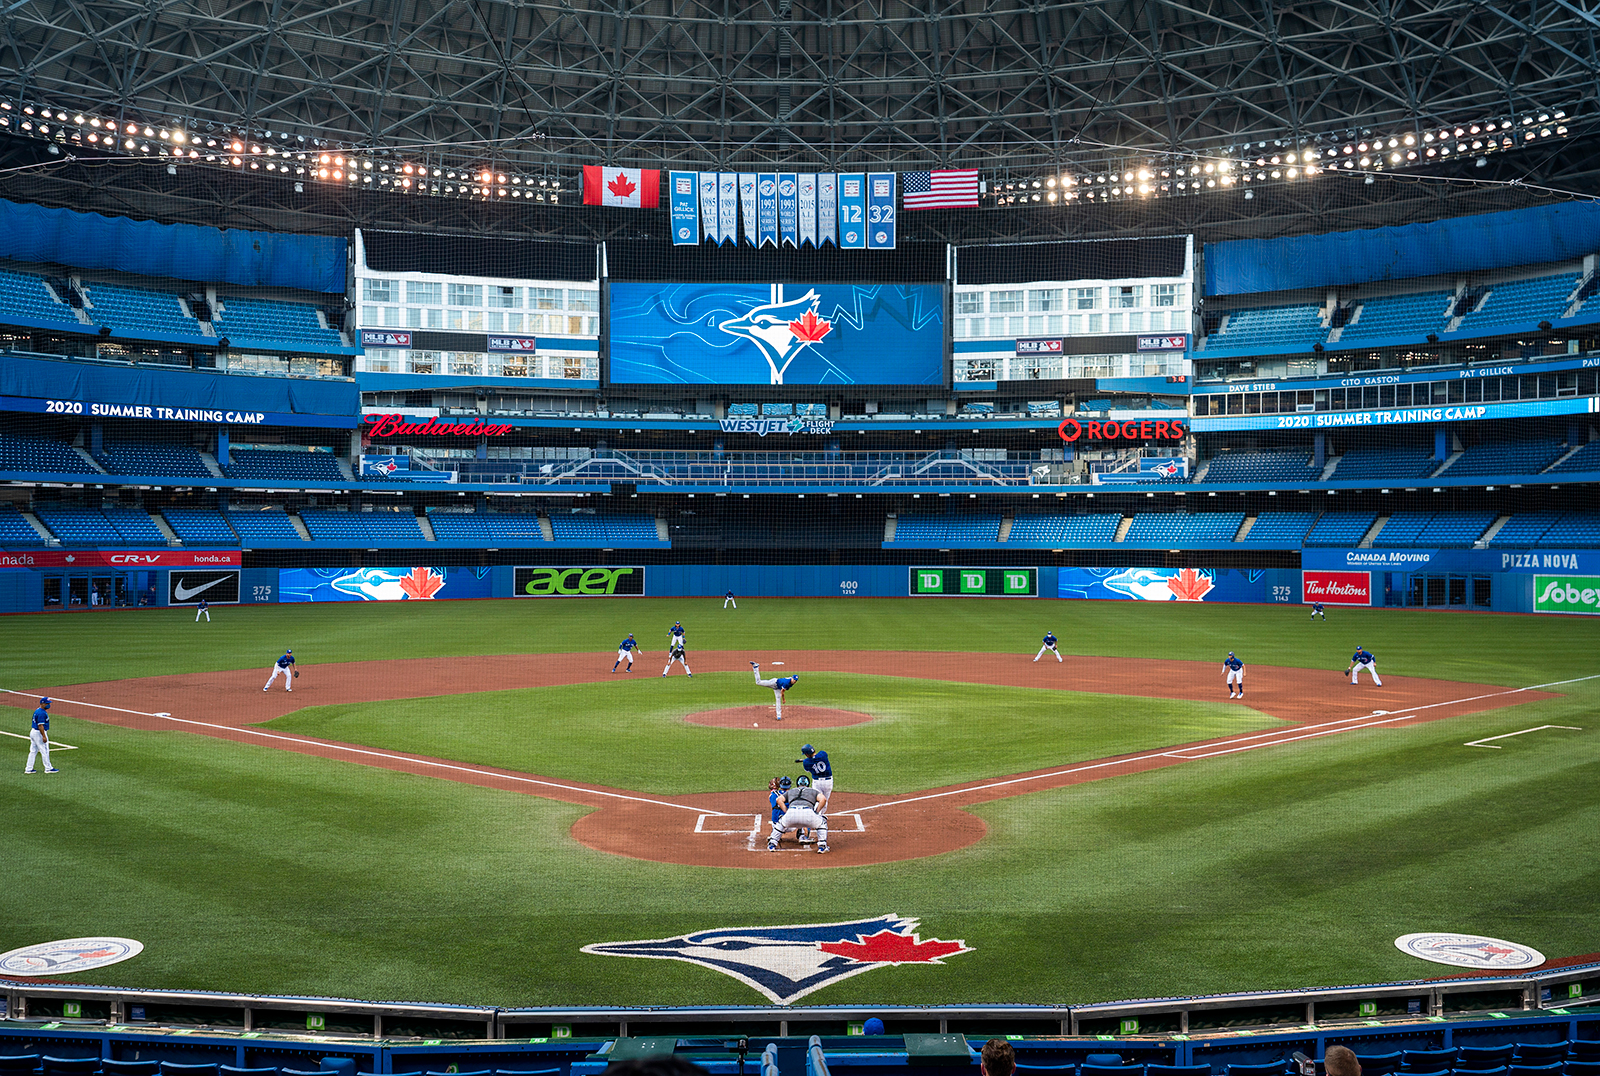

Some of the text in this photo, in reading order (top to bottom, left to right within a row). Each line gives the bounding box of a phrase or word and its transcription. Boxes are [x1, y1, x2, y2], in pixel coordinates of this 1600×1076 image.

[702, 197, 716, 207] 1985
[721, 198, 735, 208] 1989
[761, 199, 775, 209] 1992
[780, 199, 794, 210] 1993
[800, 199, 815, 209] 2015
[820, 199, 835, 209] 2016
[842, 205, 862, 223] 12
[869, 205, 894, 223] 32
[1583, 358, 1600, 367] PAU
[1460, 367, 1513, 378] PAT GILLICK
[1341, 376, 1400, 386] CITO GASTON
[1229, 383, 1276, 392] DAVE STIEB
[46, 400, 265, 423] 2020 SUMMER TRAINING CAMP
[1278, 406, 1486, 428] 2020 SUMMER TRAINING CAMP
[364, 413, 513, 437] Budweiser
[721, 420, 787, 435] WESTJET
[806, 420, 836, 428] FLIGHT
[810, 427, 832, 435] DECK
[1089, 420, 1184, 440] ROGERS
[110, 554, 161, 563] CR-V
[194, 555, 231, 563] honda.ca
[1346, 551, 1430, 562] CANADA MOVING
[1502, 553, 1579, 569] PIZZA NOVA
[525, 568, 634, 595] acer
[839, 581, 858, 589] 400
[920, 573, 941, 588] TD
[962, 574, 984, 588] TD
[1006, 574, 1027, 589] TD
[252, 586, 272, 595] 375
[1272, 586, 1291, 595] 375
[1306, 580, 1366, 596] Tim Hortons
[812, 761, 827, 774] 10
[65, 1002, 80, 1014] TD
[1361, 1002, 1375, 1013] TD
[310, 1015, 324, 1027] TD
[1122, 1020, 1136, 1031] TD
[554, 1026, 570, 1037] TD
